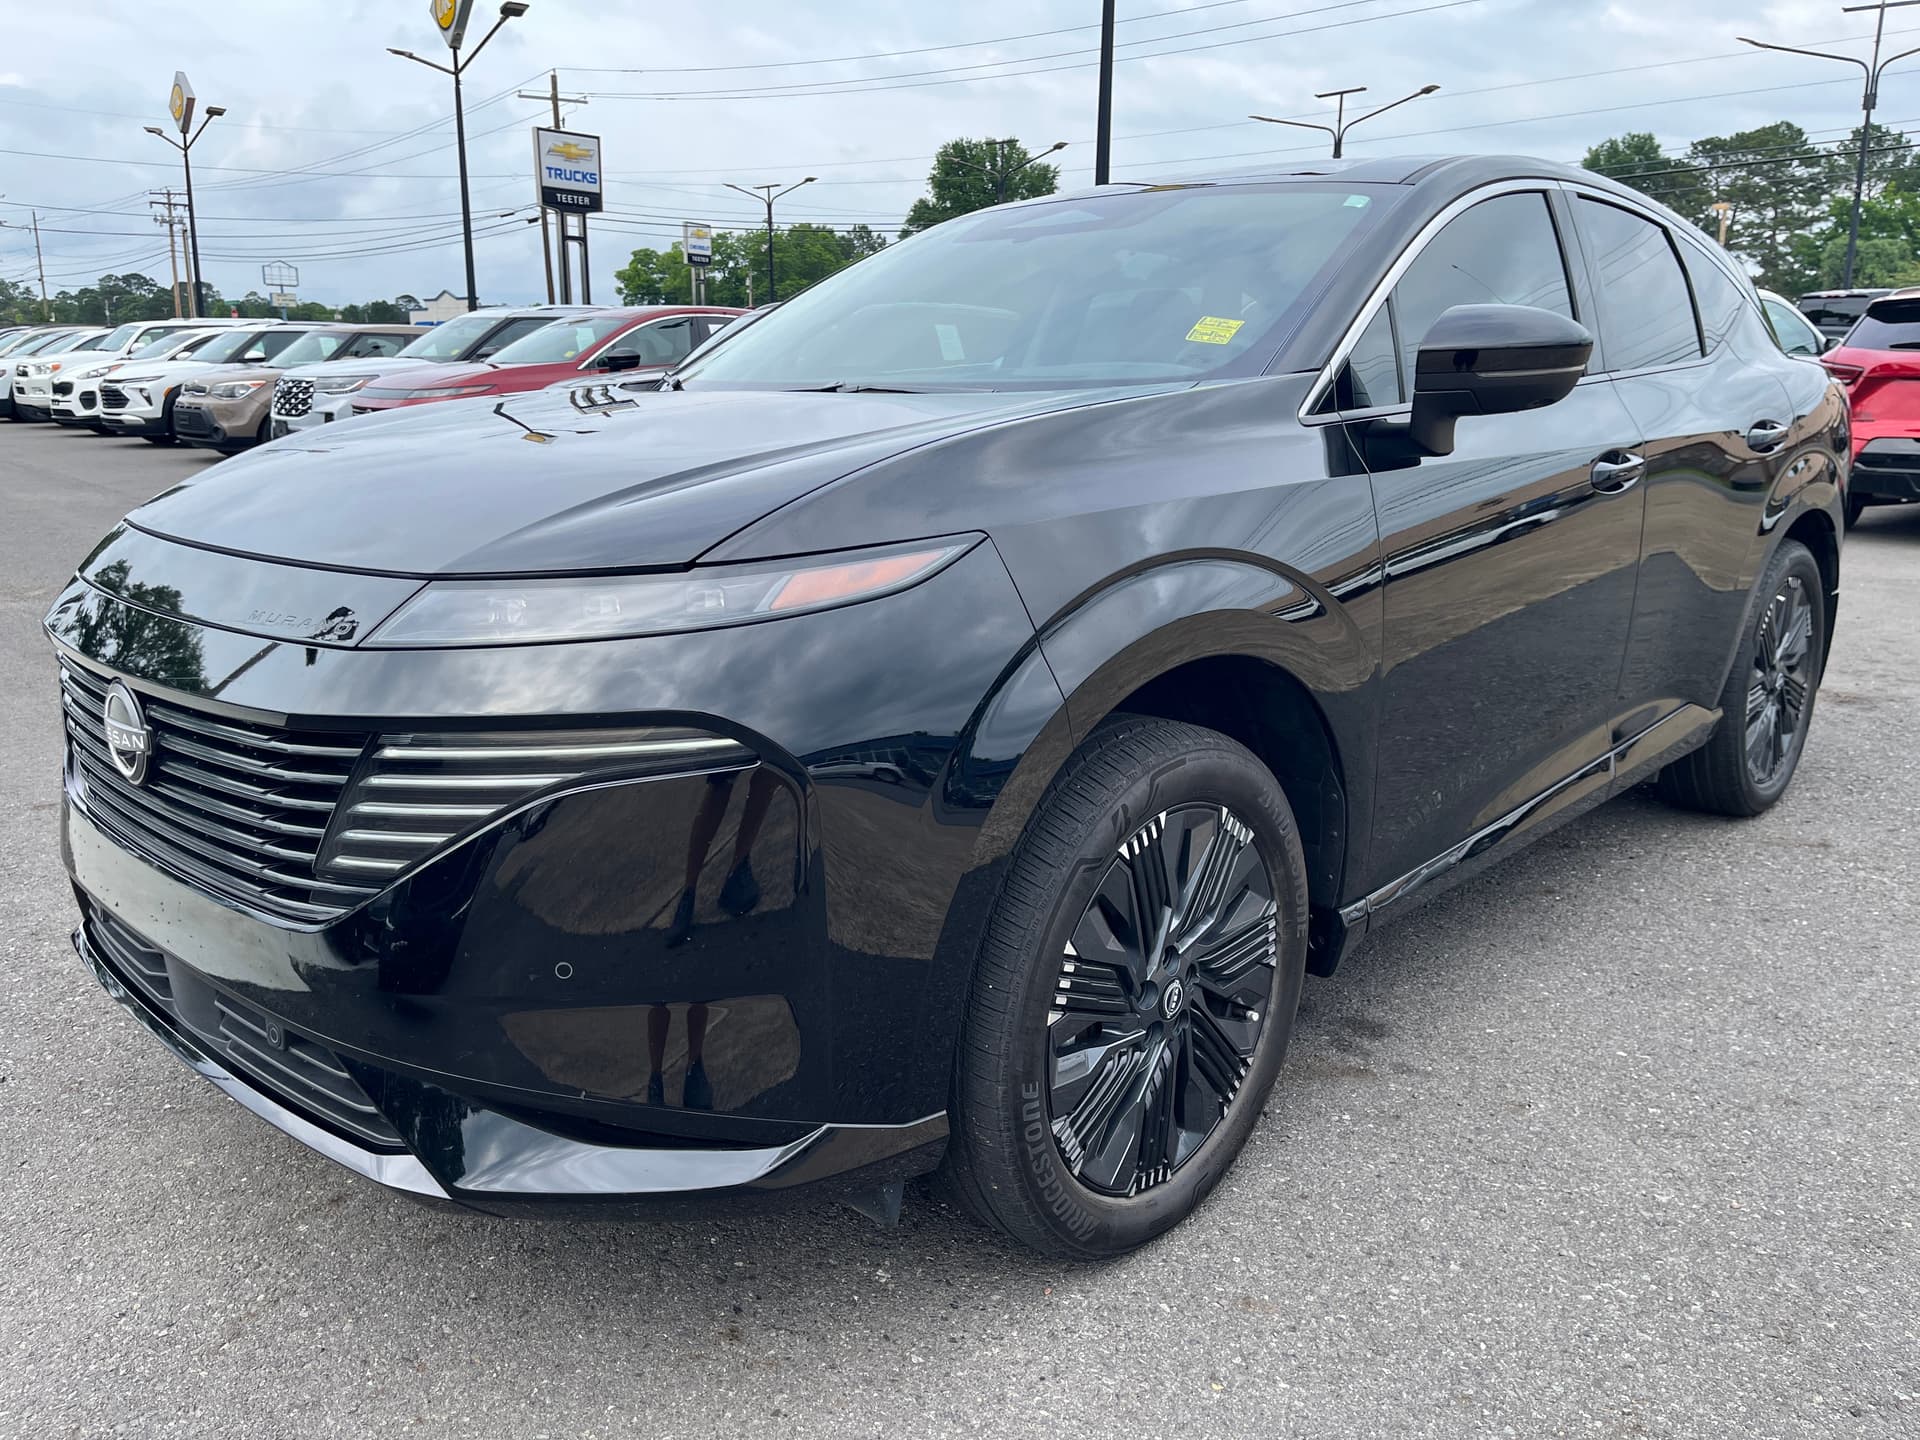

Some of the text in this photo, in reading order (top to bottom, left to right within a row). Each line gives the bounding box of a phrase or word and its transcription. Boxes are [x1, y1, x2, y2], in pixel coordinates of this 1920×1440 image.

[545, 166, 597, 185] TRUCKS
[556, 193, 590, 206] TEETER
[1021, 1080, 1097, 1243] BRIDGESTONE
